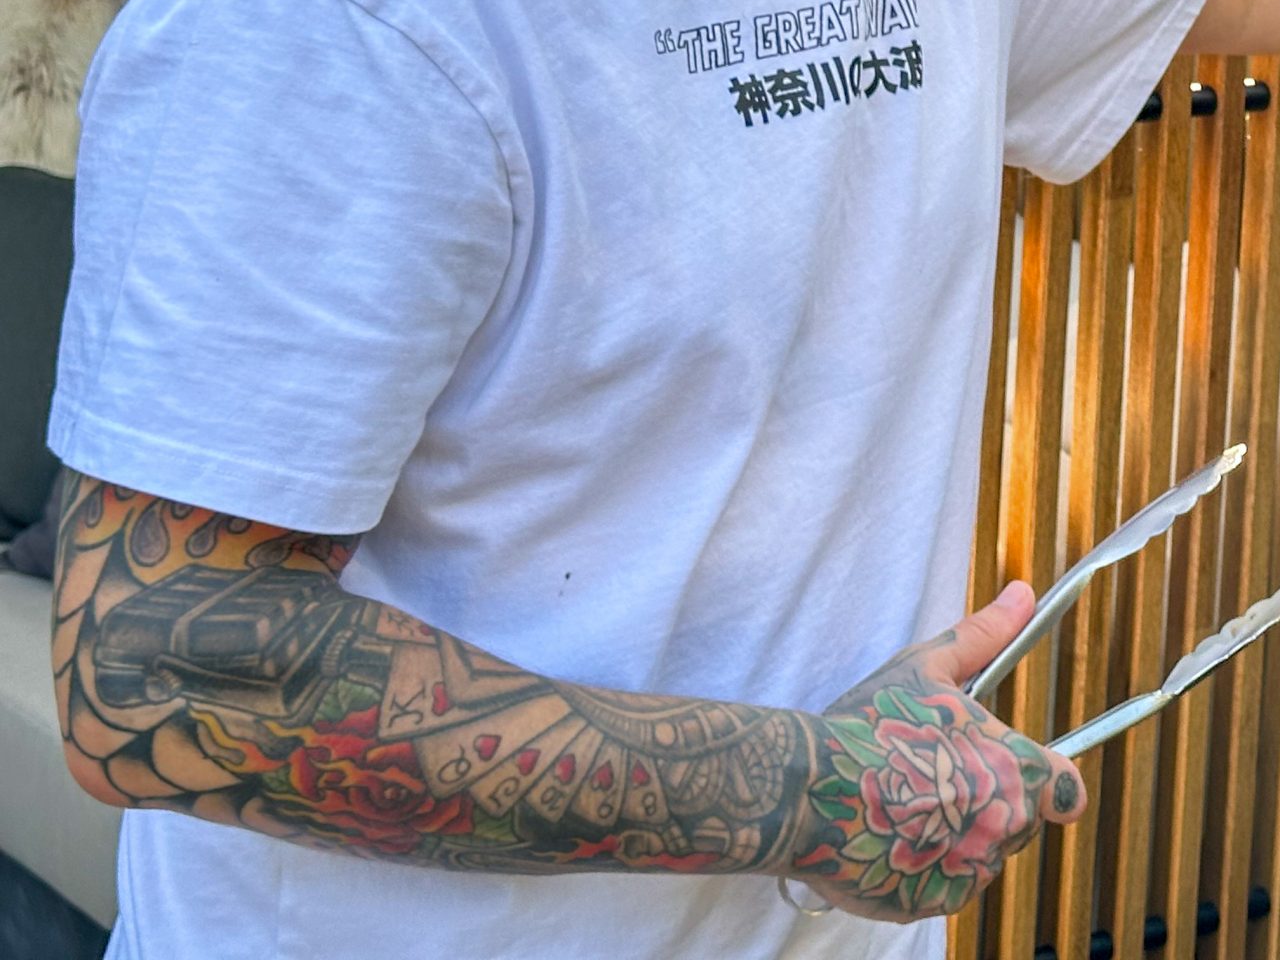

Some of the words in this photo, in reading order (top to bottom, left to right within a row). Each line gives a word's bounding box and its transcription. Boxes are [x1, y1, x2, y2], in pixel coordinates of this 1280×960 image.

[653, 20, 745, 74] “THE
[388, 684, 425, 729] K
[438, 744, 472, 785] Q
[487, 776, 520, 808] J
[641, 791, 658, 817] 8
